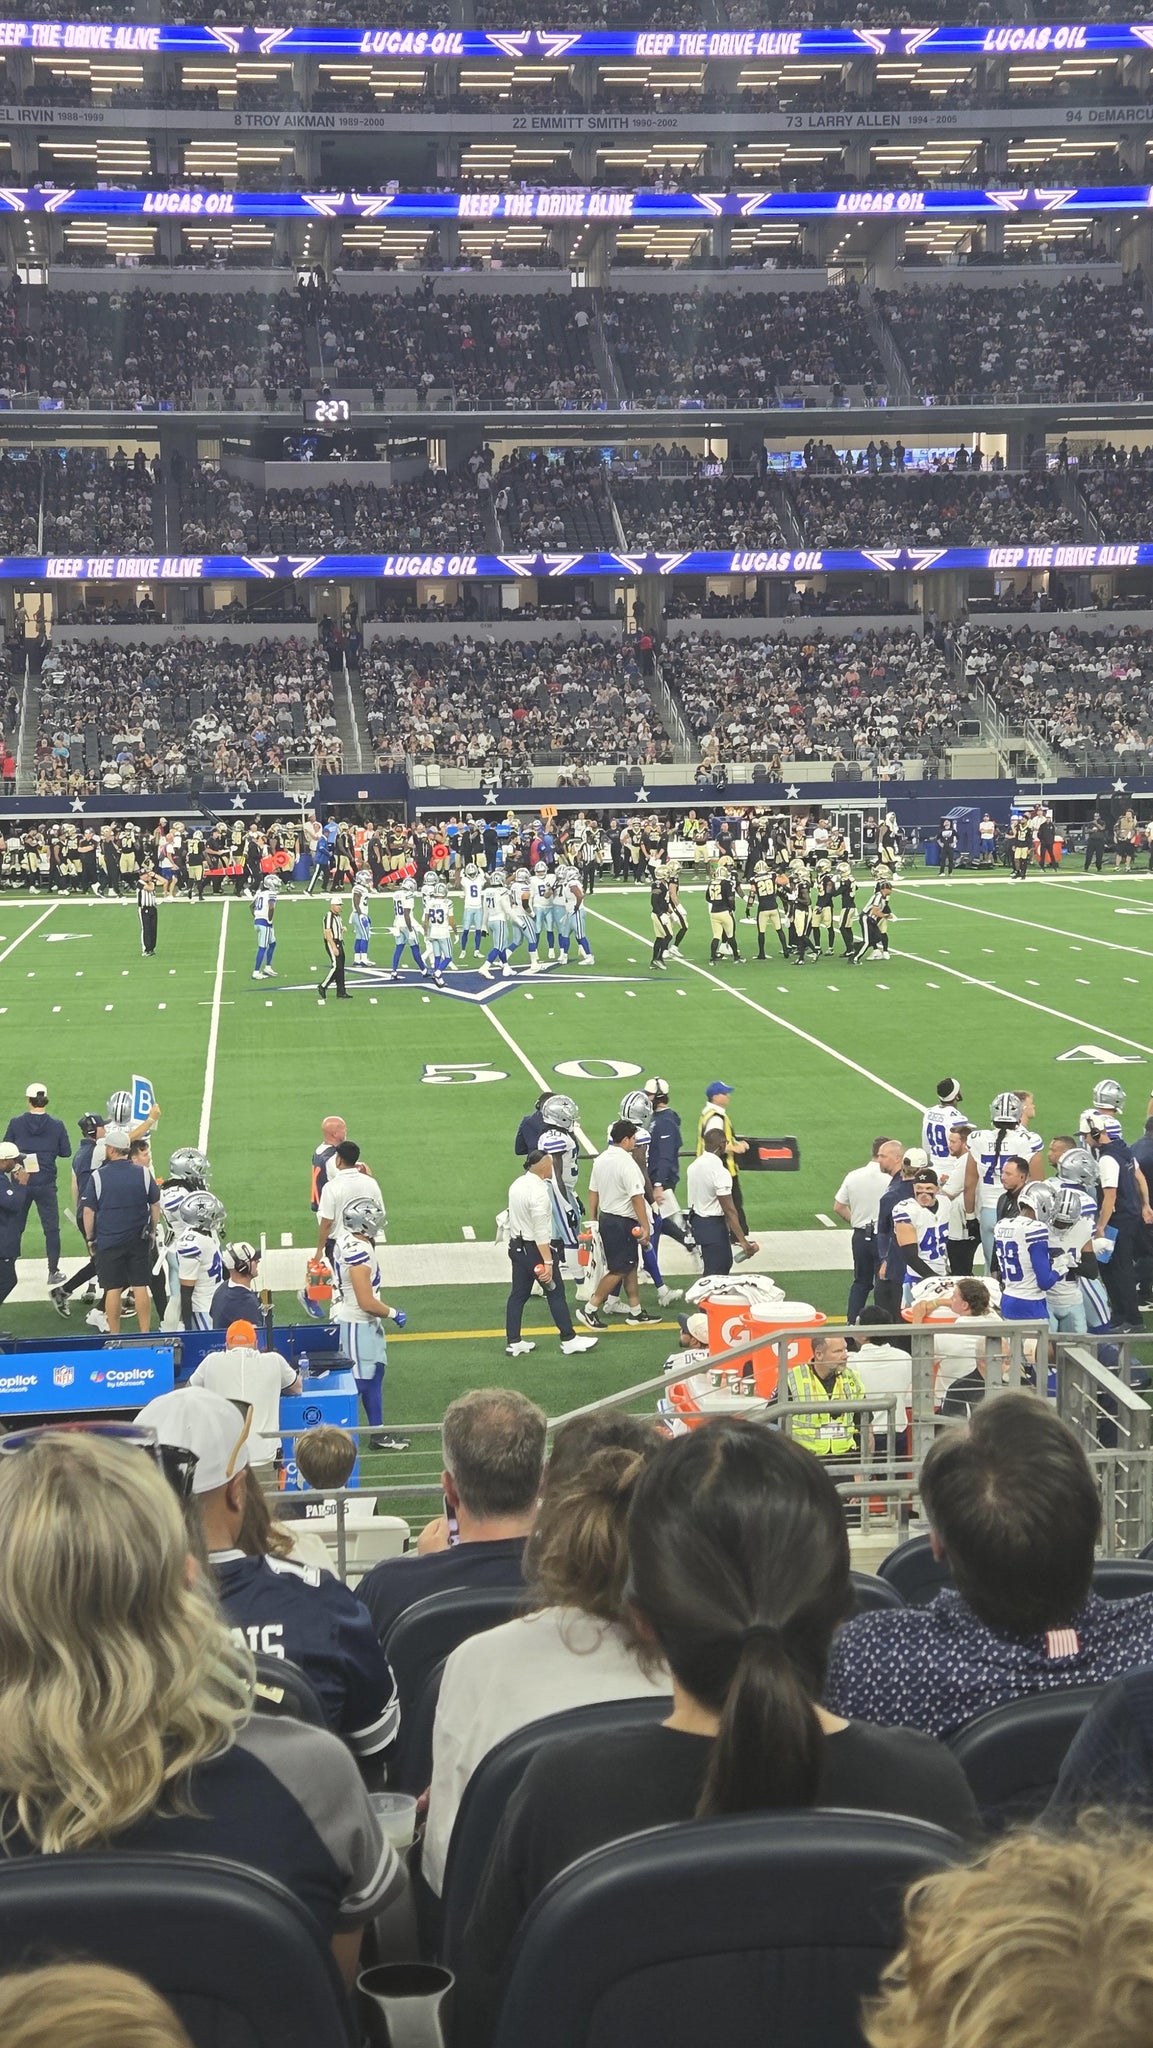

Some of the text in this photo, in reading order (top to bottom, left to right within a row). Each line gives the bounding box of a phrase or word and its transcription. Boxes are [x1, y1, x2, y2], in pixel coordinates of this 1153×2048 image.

[31, 24, 62, 47] THE
[64, 26, 113, 49] DRIVE
[114, 28, 160, 50] ALIVE
[360, 32, 464, 54] LUCAS OIL
[636, 32, 802, 55] KEEP THE DRIVE ALIVE
[983, 27, 1087, 50] LUCAS OIL
[18, 109, 54, 122] IRVIN
[234, 116, 384, 127] 8 TROY AIKMAN 1989-2000
[512, 117, 678, 129] 22 EMMITT SMITH 1990-2002
[786, 116, 802, 128] 73
[809, 115, 852, 127] LARRY
[857, 114, 900, 127] ALLEN
[1066, 110, 1082, 122] 94
[143, 194, 234, 213] LUCAS OIL
[458, 194, 634, 216] KEEP THE DRIVE ALIVE
[836, 193, 926, 211] LUCAS OIL
[315, 400, 349, 421] 2:27
[730, 552, 823, 571] LUCAS OIL
[988, 545, 1139, 567] KEEP THE DRIVE ALIVE
[46, 558, 203, 577] KEEP THE DRIVE ALIVE
[384, 556, 477, 576] LUCAS OIL
[470, 884, 478, 898] 6
[486, 897, 495, 909] 71
[429, 909, 444, 924] 83
[138, 1089, 153, 1115] B
[988, 1142, 1008, 1152] PE
[721, 1317, 752, 1349] G
[106, 1368, 154, 1382] Copilot
[117, 1380, 145, 1388] Microsoft
[306, 1502, 350, 1518] PARSOS
